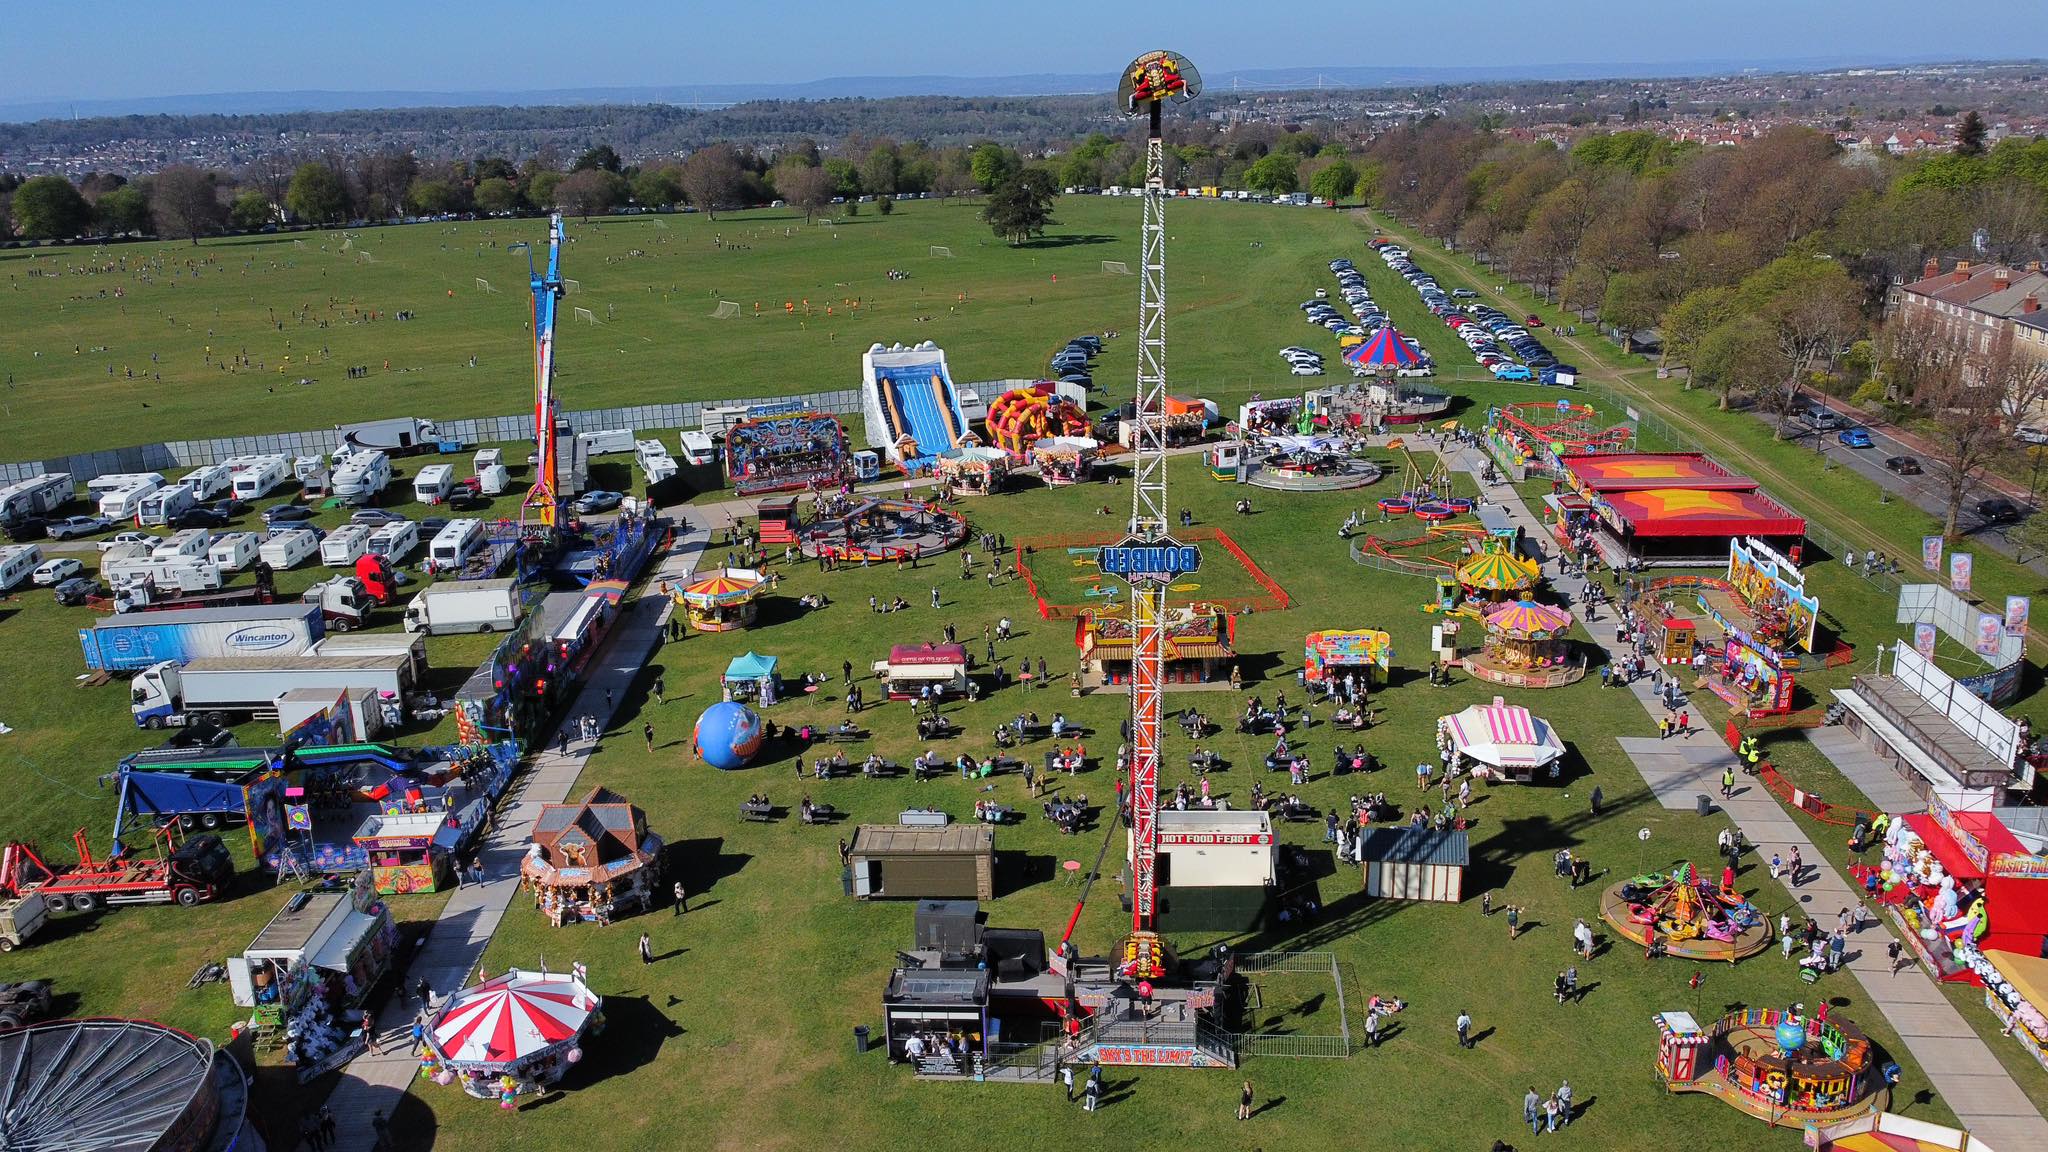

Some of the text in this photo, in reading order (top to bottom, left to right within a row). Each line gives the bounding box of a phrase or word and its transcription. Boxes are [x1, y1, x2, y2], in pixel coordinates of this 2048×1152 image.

[1105, 547, 1195, 572] BOMBER
[235, 634, 288, 642] Wincanton
[1161, 834, 1253, 844] HOT FOOD FEAST
[1098, 1047, 1194, 1064] SKY'S THE LIMIT
